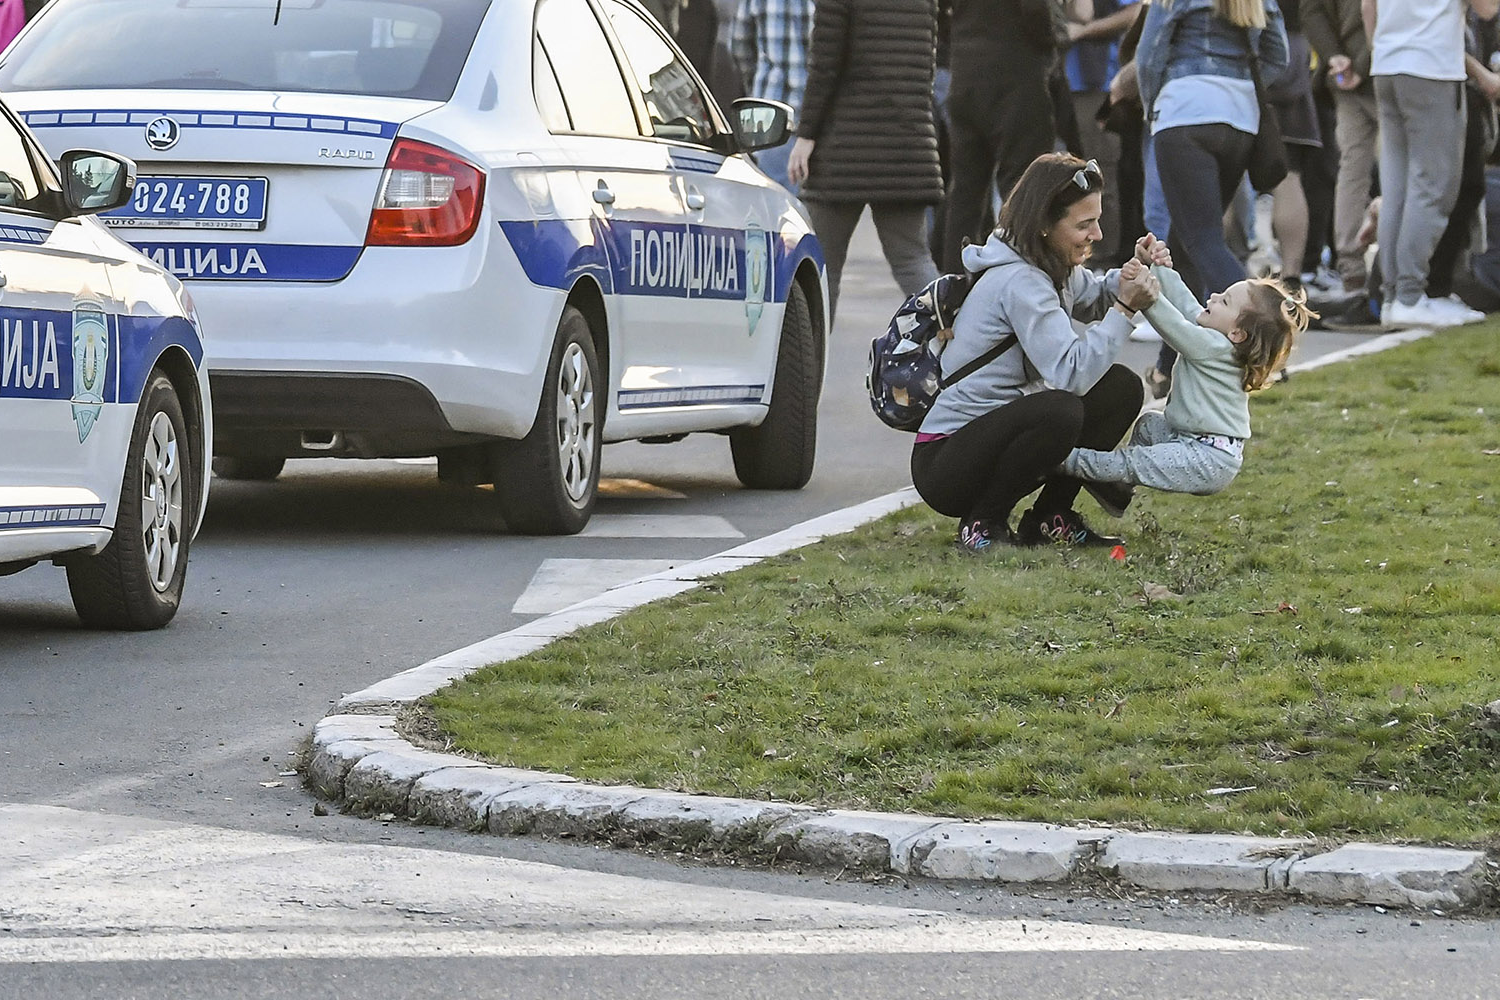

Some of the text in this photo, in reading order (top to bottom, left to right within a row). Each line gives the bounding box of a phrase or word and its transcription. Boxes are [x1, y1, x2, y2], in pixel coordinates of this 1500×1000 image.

[318, 148, 376, 160] RAPID
[142, 247, 268, 277] ИЦИЈА
[629, 229, 739, 296] ПОЛИЦИЈА
